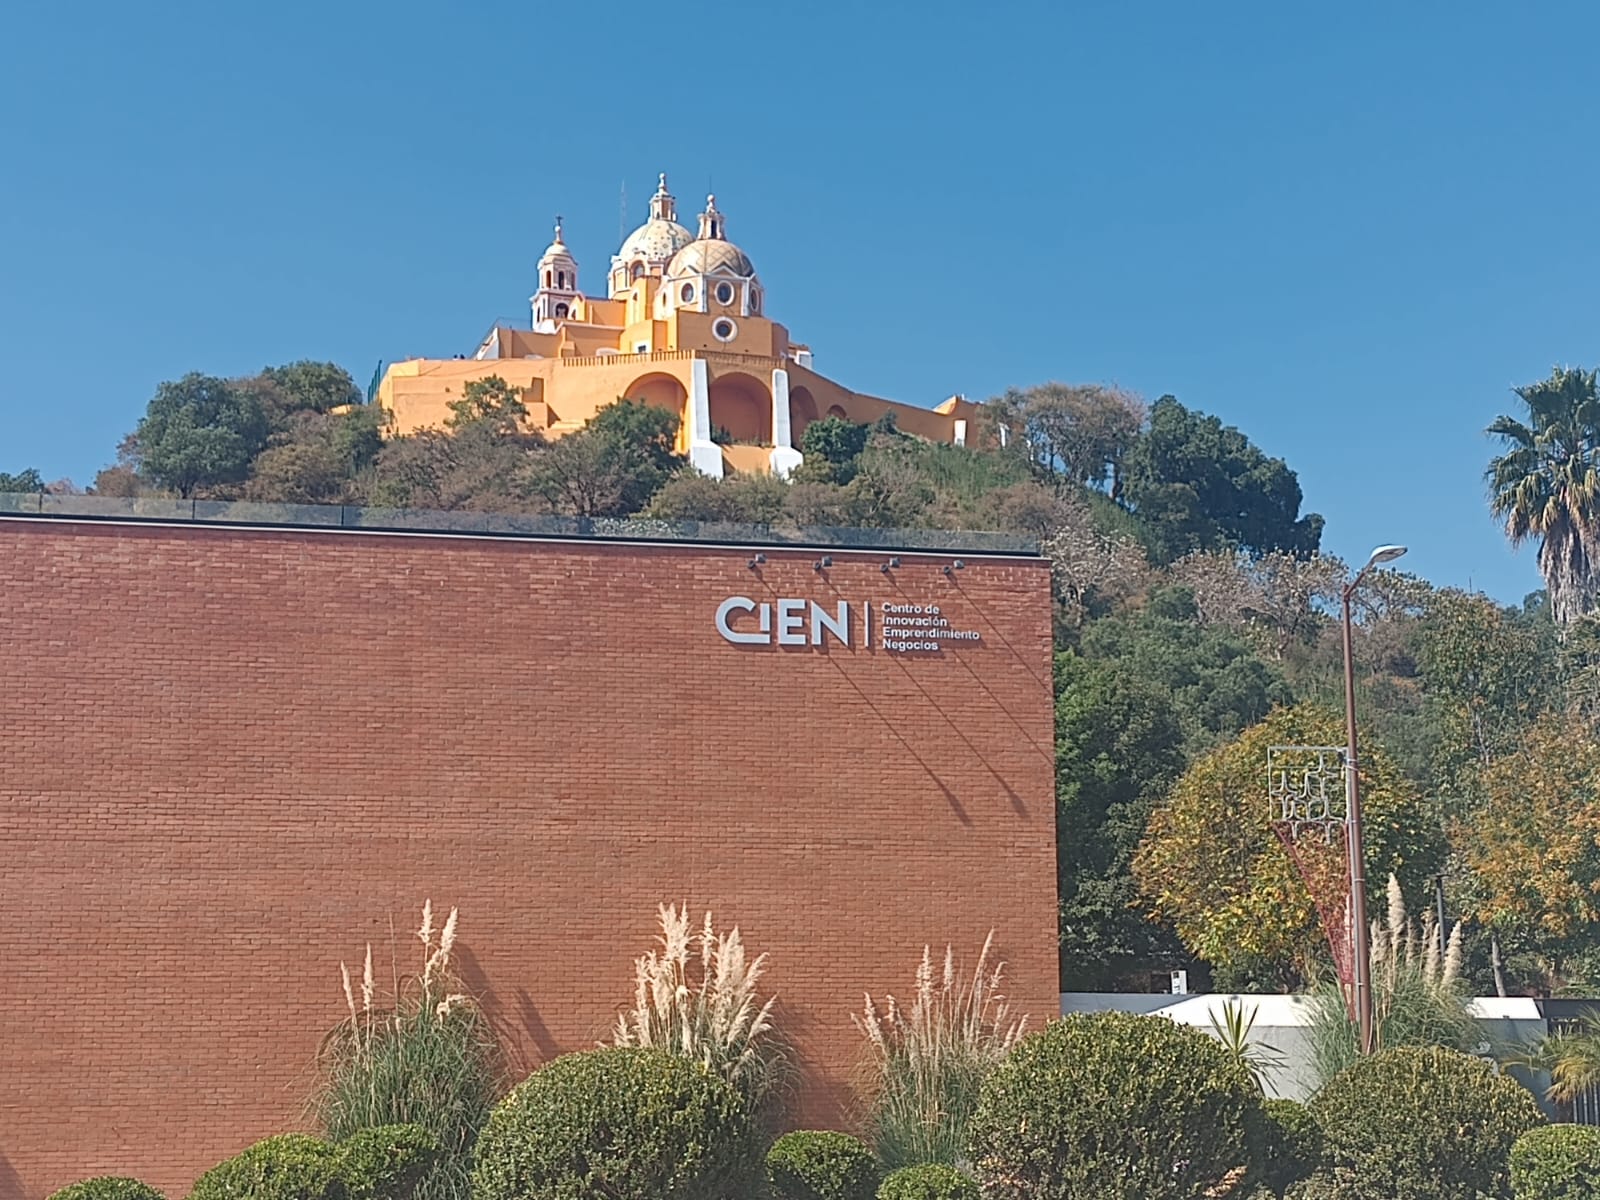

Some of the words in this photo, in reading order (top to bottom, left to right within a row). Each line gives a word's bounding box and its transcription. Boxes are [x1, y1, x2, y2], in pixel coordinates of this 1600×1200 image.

[881, 602, 921, 614] Centro
[924, 604, 940, 615] de
[715, 596, 848, 646] CIEN
[882, 614, 948, 627] Innovación
[882, 626, 980, 640] Emprendimiento
[882, 638, 939, 652] Negocios
